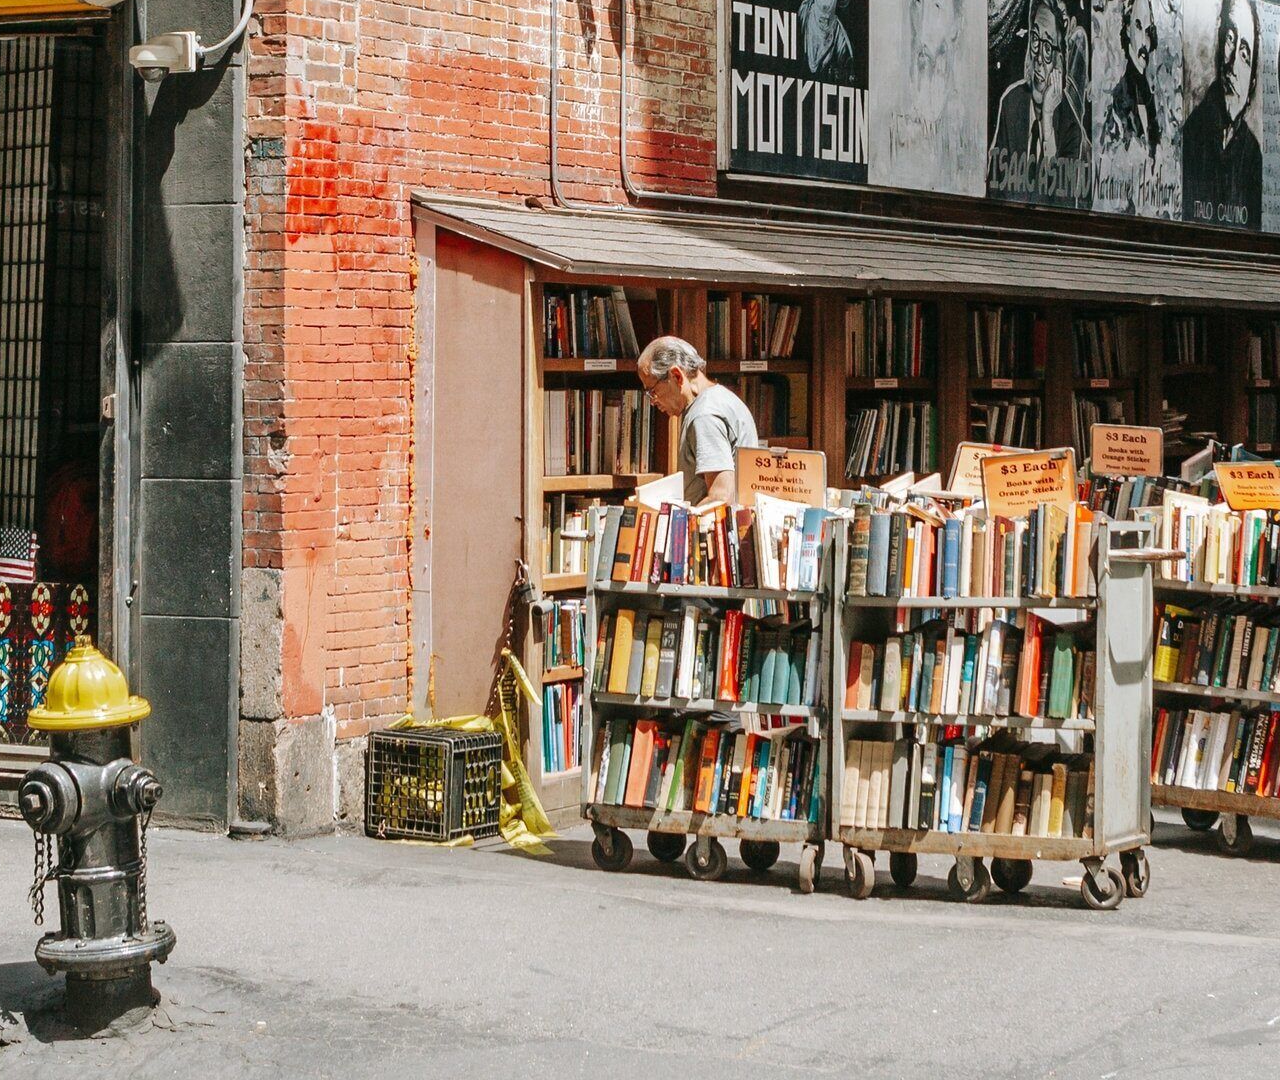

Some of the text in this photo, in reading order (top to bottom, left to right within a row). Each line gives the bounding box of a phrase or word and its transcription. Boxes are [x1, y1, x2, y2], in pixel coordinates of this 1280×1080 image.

[732, 1, 797, 60] TONI
[989, 146, 1036, 193] ISAAC
[1194, 200, 1249, 224] ITALO CALVINO
[1106, 432, 1147, 444] $3 Each
[1108, 447, 1127, 455] Books
[755, 457, 806, 470] $3 Each
[1102, 454, 1151, 464] Orange Sticker
[1001, 460, 1058, 476] $3 Each
[1231, 471, 1275, 479] $3 Each
[751, 483, 812, 494] Orange Sticker
[1006, 477, 1055, 488] Books with
[999, 485, 1064, 498] Orange Sticker
[1242, 621, 1253, 656] BLACKWATER
